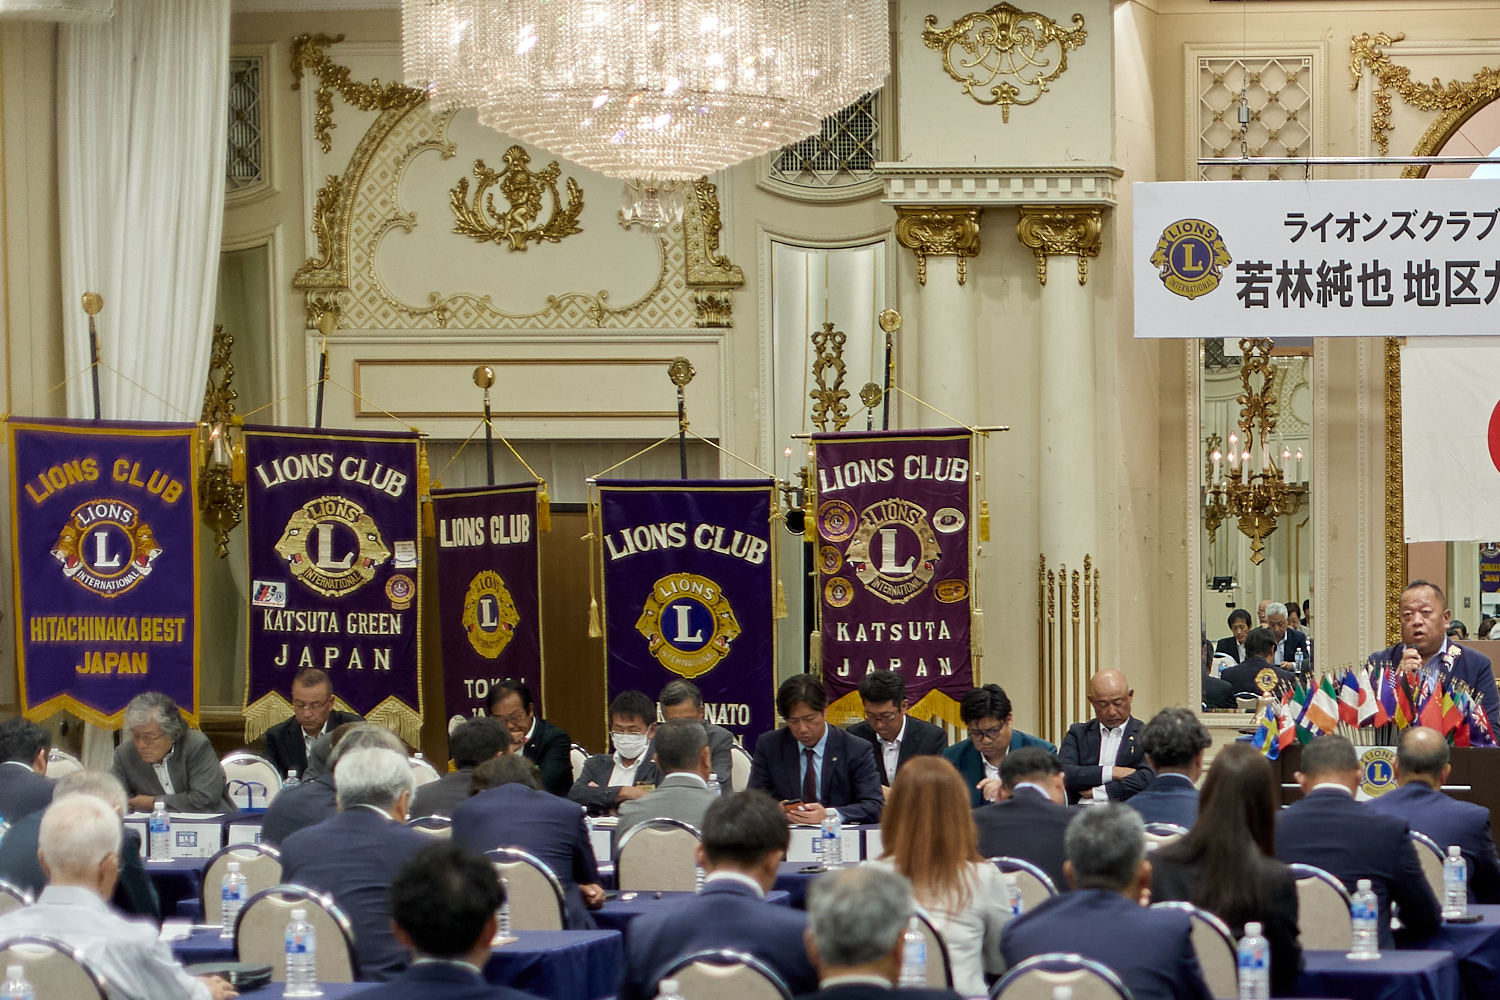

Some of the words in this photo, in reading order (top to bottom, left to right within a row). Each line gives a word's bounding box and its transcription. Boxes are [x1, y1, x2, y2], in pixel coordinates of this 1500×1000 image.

[1168, 221, 1216, 240] LIONS
[1182, 243, 1204, 272] L
[1168, 278, 1216, 296] INTERNATIONAL
[25, 458, 99, 504] LIONS
[112, 459, 183, 503] CLUB
[254, 453, 335, 490] LIONS
[339, 456, 408, 497] CLUB
[818, 457, 895, 494] LIONS
[904, 454, 970, 483] CLUB
[77, 504, 133, 525] LIONS
[309, 501, 360, 523] LIONS
[868, 502, 922, 526] LIONS
[440, 516, 485, 548] LIONS
[490, 513, 530, 545] CLUB
[94, 531, 120, 567] L
[316, 523, 355, 569] L
[603, 521, 688, 561] LIONS
[693, 523, 769, 566] CLUB
[879, 528, 916, 574] L
[77, 570, 140, 590] INTERNATIONAL
[303, 568, 364, 591] INTERNATIONAL
[476, 576, 500, 594] LIONS
[659, 579, 715, 601] LIONS
[871, 577, 924, 597] INTERNATIONAL
[263, 608, 340, 633] KATSUTA
[347, 612, 402, 635] GREEN
[480, 599, 498, 628] L
[672, 604, 704, 643] L
[31, 616, 139, 642] HITACHINAKA
[140, 617, 186, 642] BEST
[836, 619, 951, 642] KATSUTA
[75, 651, 148, 674] JAPAN
[273, 643, 391, 671] JAPAN
[837, 657, 952, 677] JAPAN
[1374, 763, 1388, 782] L
